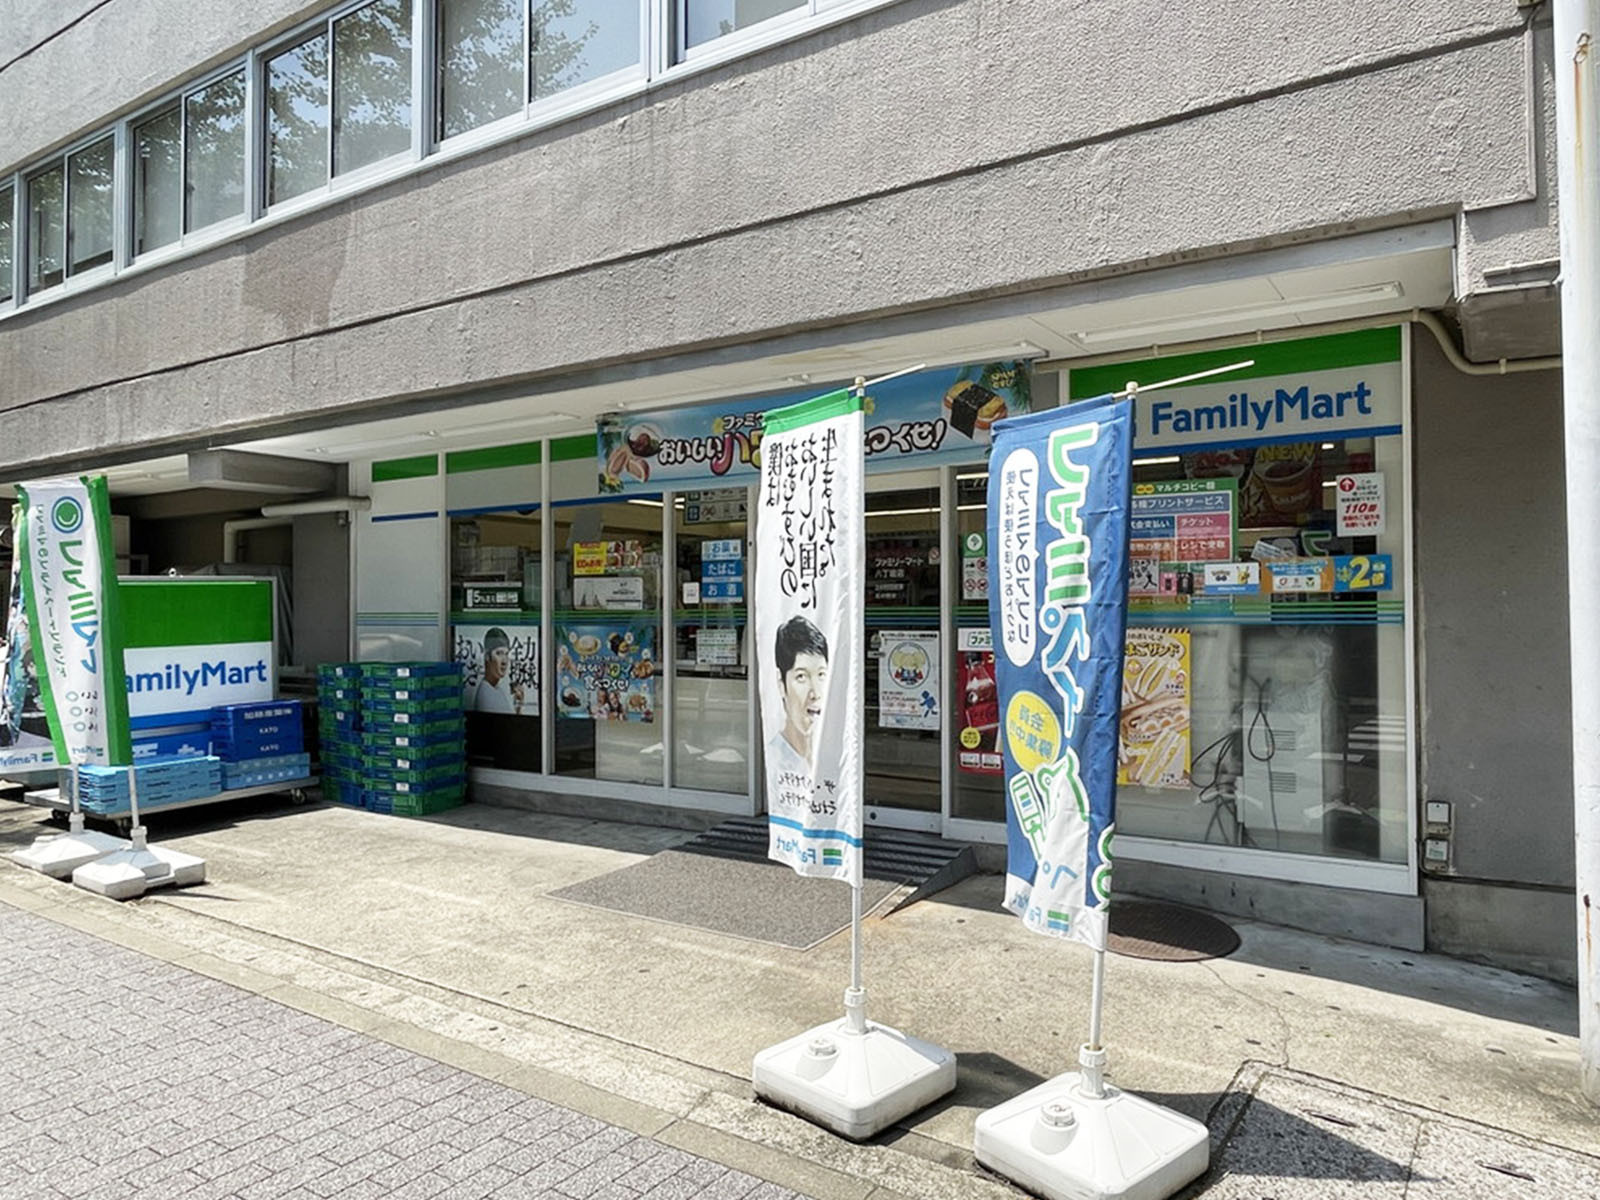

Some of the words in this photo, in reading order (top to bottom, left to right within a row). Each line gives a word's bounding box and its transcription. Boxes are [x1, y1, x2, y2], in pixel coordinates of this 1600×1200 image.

[1152, 382, 1371, 434] FamilyMart
[863, 418, 947, 455] つくせ!
[509, 636, 536, 662] 全力
[125, 659, 268, 697] amilyMart
[259, 726, 279, 735] KATO
